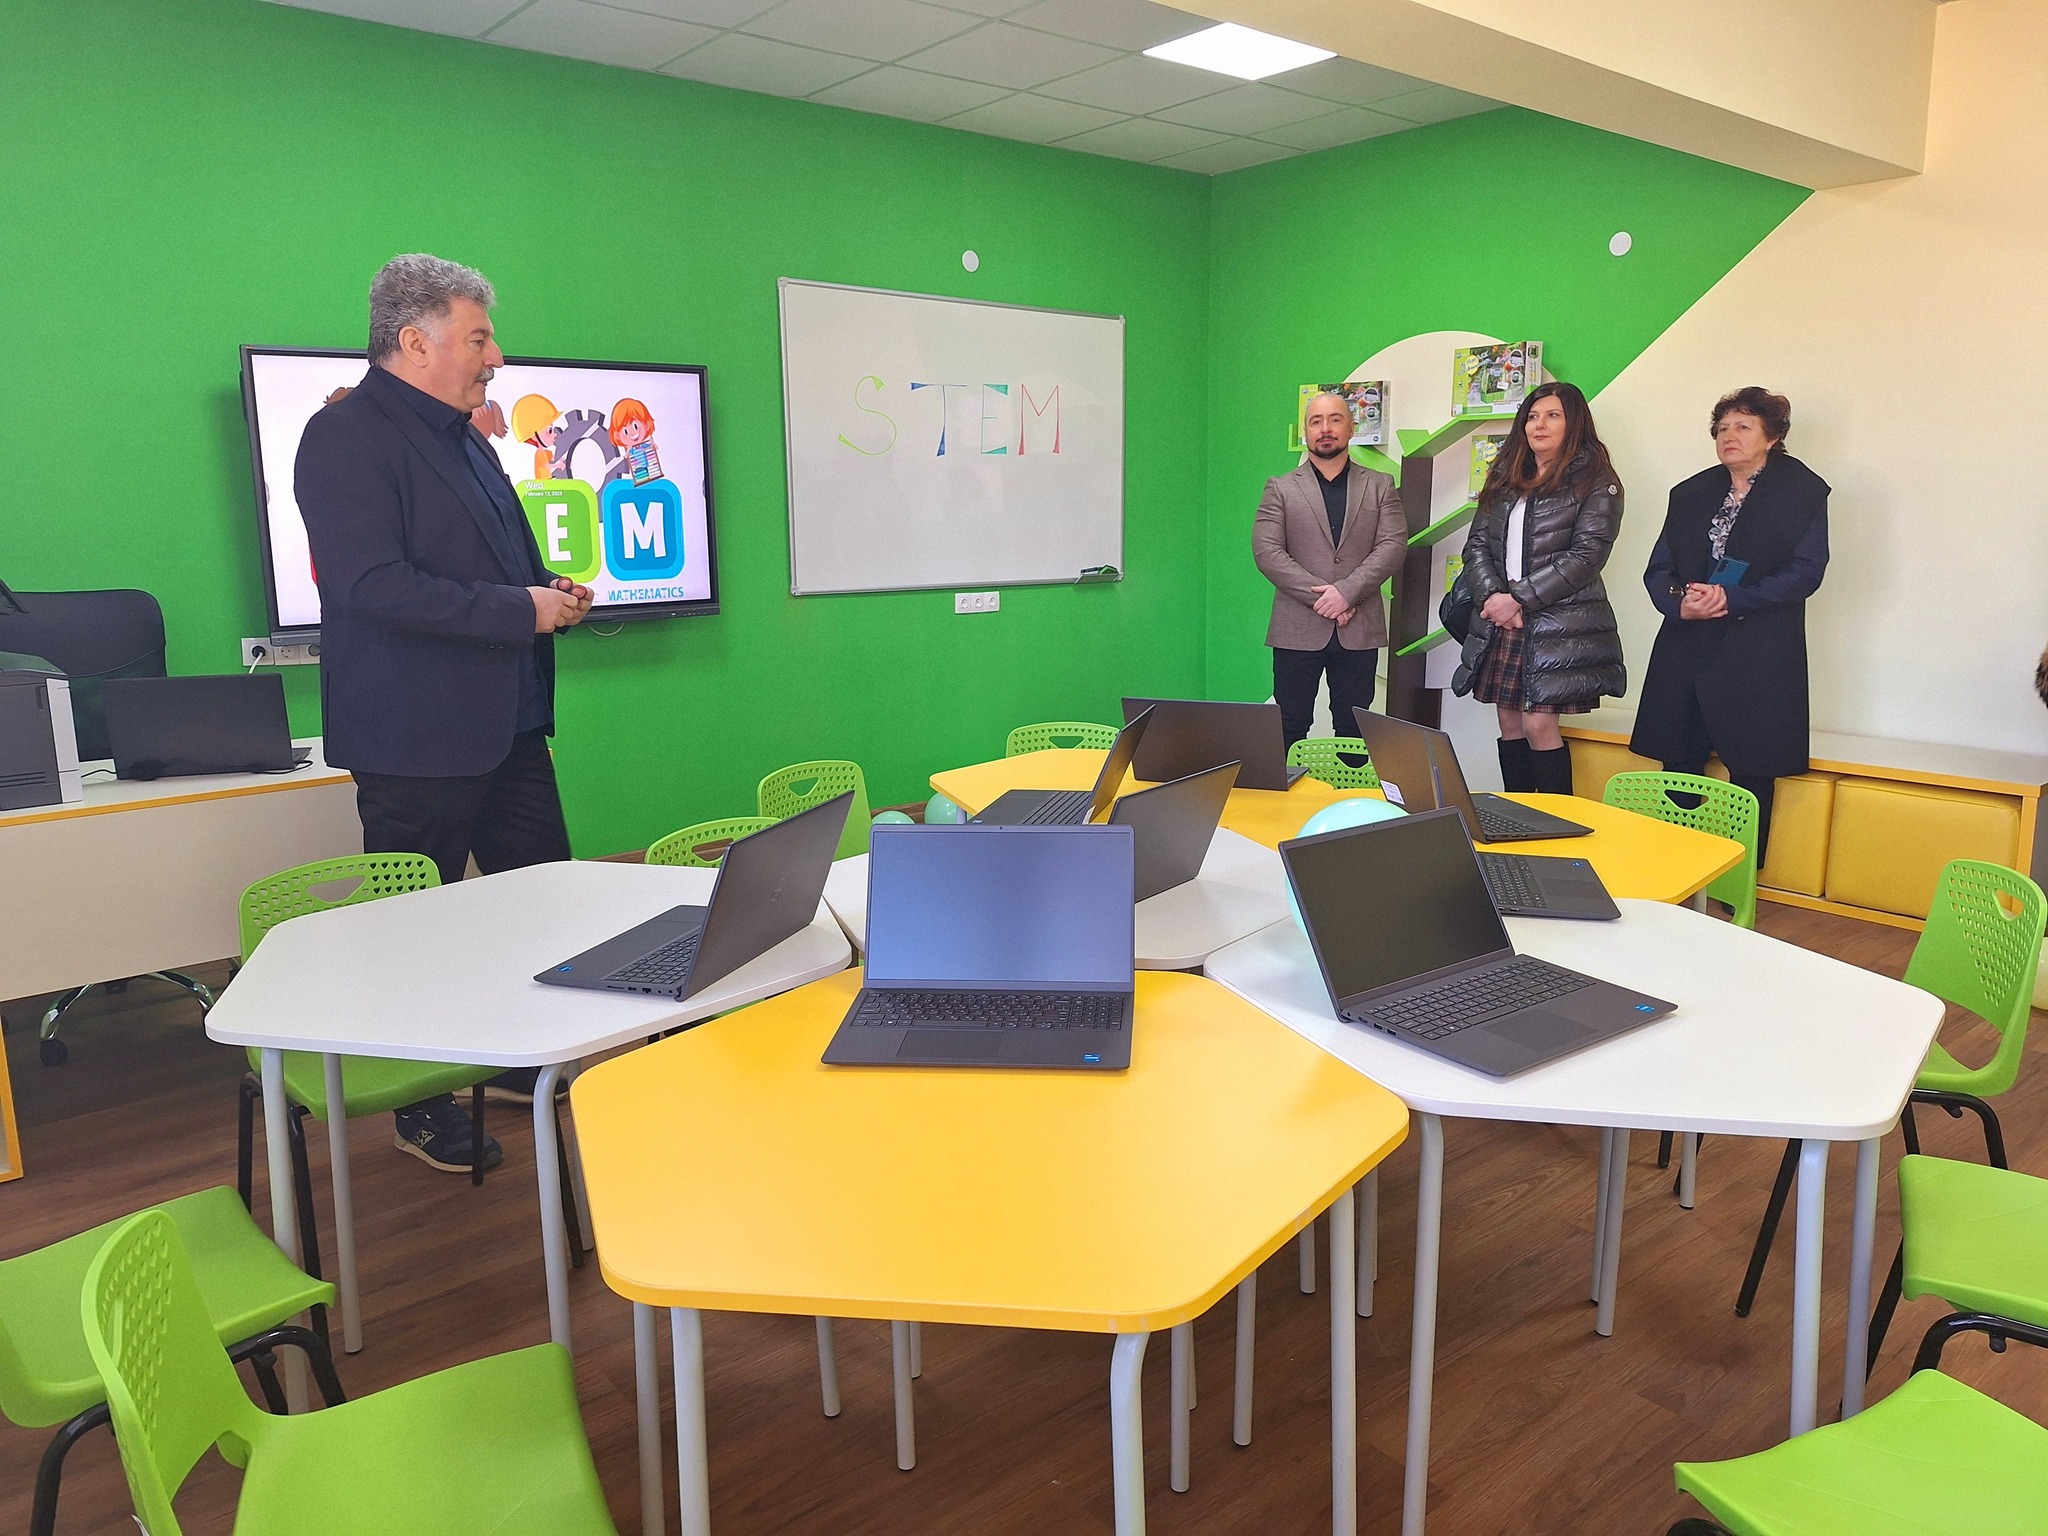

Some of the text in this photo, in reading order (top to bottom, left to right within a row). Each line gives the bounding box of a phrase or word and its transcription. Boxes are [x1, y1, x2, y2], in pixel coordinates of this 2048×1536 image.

[837, 375, 1060, 457] STEM
[525, 481, 544, 490] Wed
[608, 586, 684, 602] MATHEMATICS
